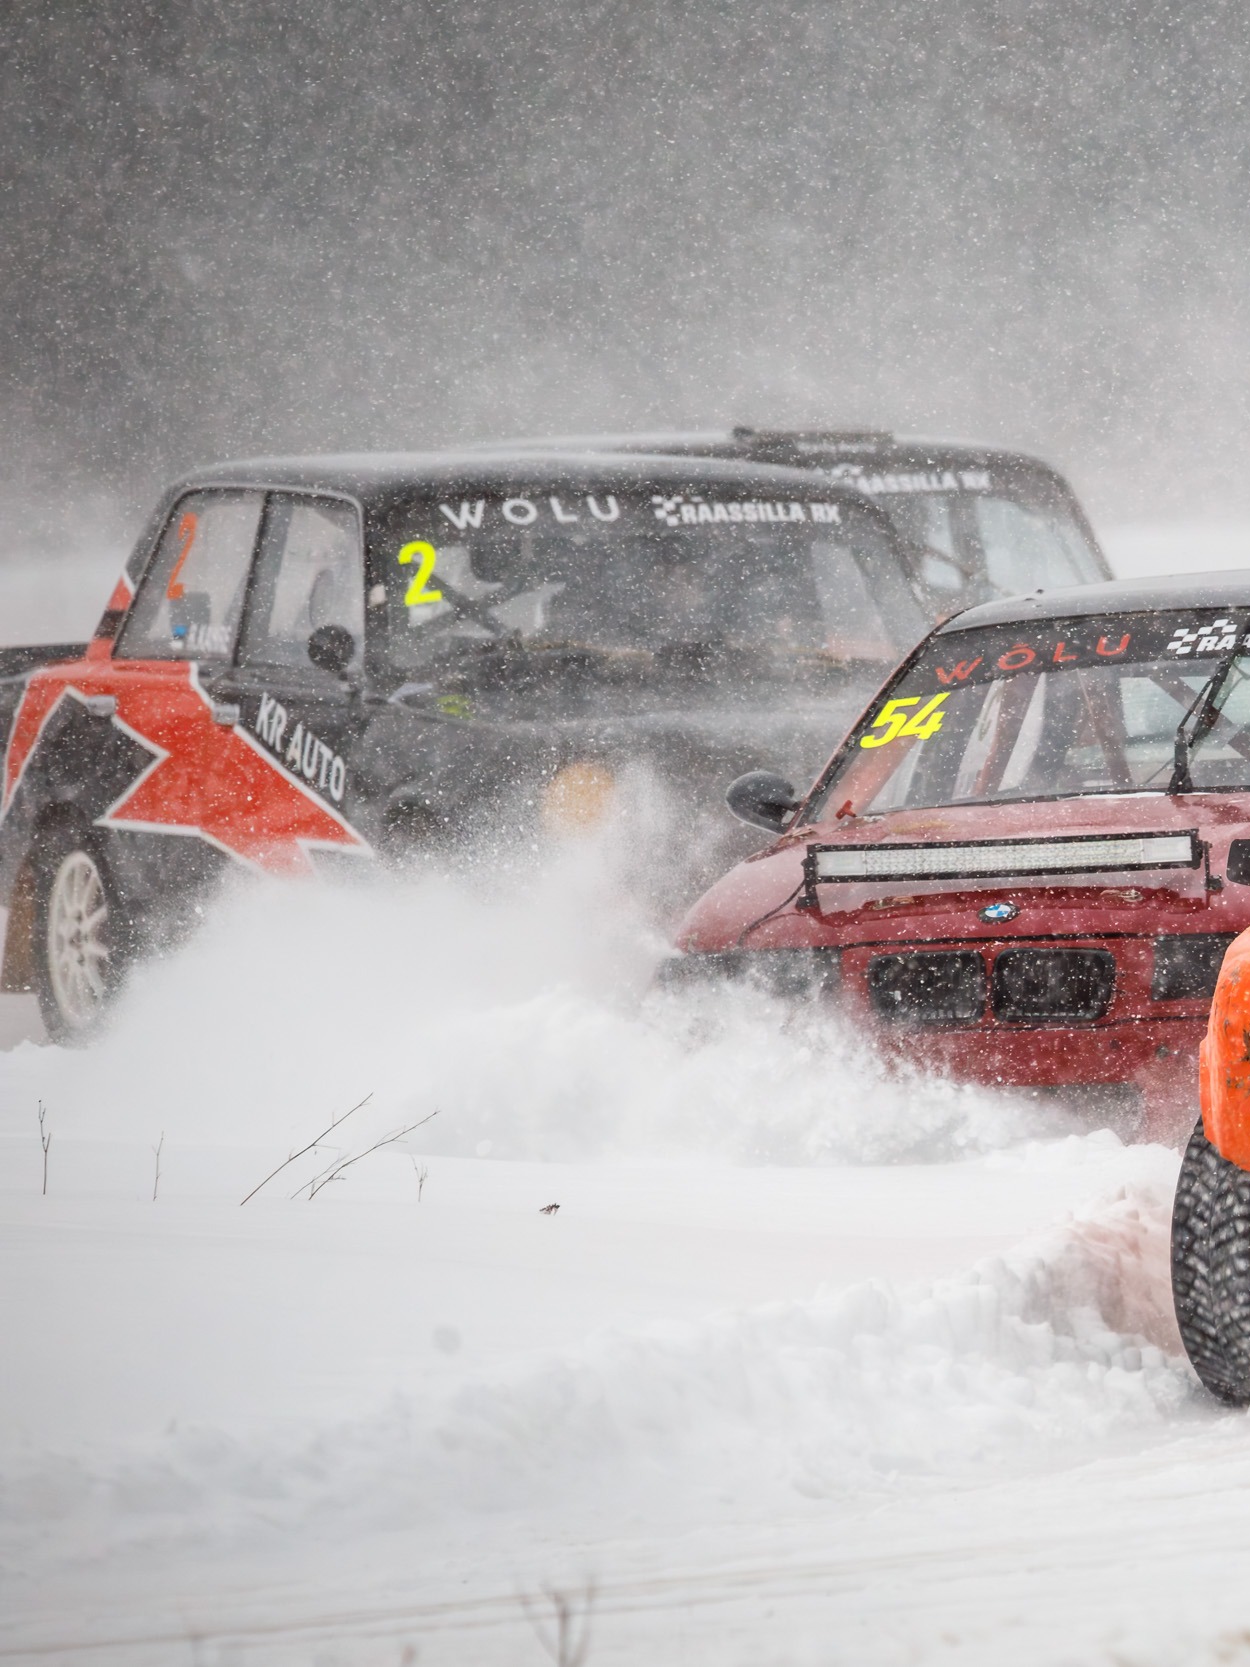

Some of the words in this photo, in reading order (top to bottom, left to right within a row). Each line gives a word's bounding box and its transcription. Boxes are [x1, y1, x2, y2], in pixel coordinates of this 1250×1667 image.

[680, 501, 806, 525] RAASSILLA
[810, 501, 842, 524] RX
[843, 471, 958, 494] AASSILLA
[166, 511, 198, 600] 2
[398, 540, 443, 607] 2
[256, 691, 288, 753] KR
[286, 721, 345, 802] AUTO
[860, 692, 951, 749] 54
